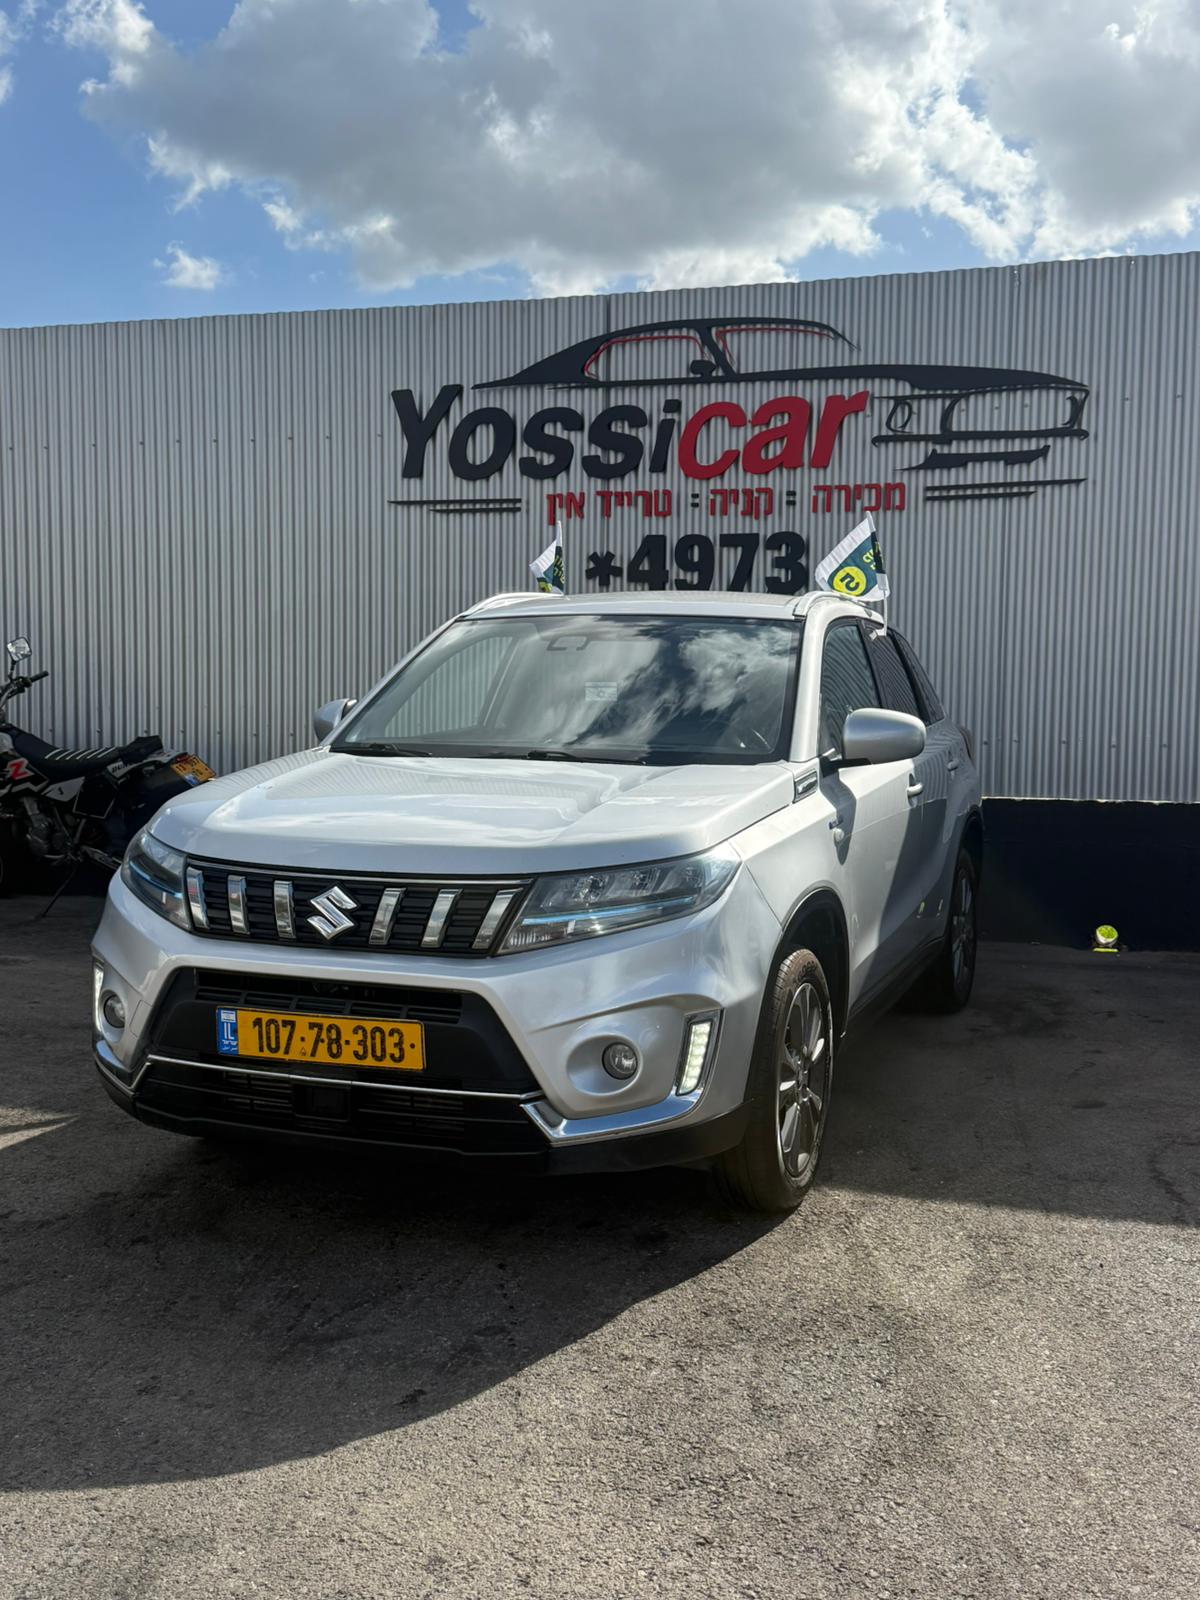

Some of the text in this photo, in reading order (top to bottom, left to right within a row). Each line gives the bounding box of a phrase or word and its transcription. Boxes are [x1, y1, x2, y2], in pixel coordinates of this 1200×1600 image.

[391, 384, 870, 481] Yossicar
[546, 491, 586, 526] אין
[595, 489, 673, 519] טרייד
[709, 487, 774, 520] קניה
[812, 482, 906, 513] מכירה
[223, 1022, 235, 1040] IL
